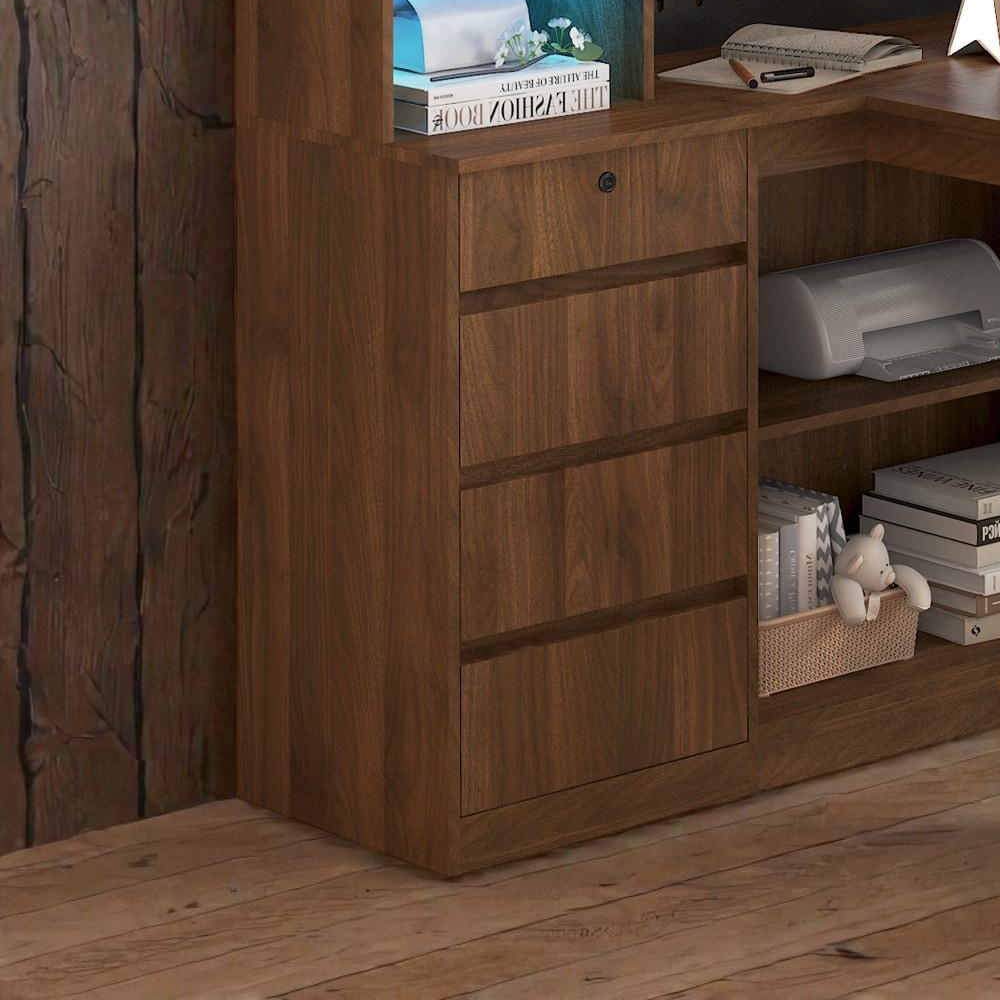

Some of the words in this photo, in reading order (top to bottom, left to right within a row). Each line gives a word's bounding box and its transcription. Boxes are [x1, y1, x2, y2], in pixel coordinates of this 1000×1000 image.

[583, 69, 600, 80] THE
[500, 79, 534, 92] BEAUTY
[536, 78, 547, 88] OF
[982, 520, 1000, 541] РЭЙ
